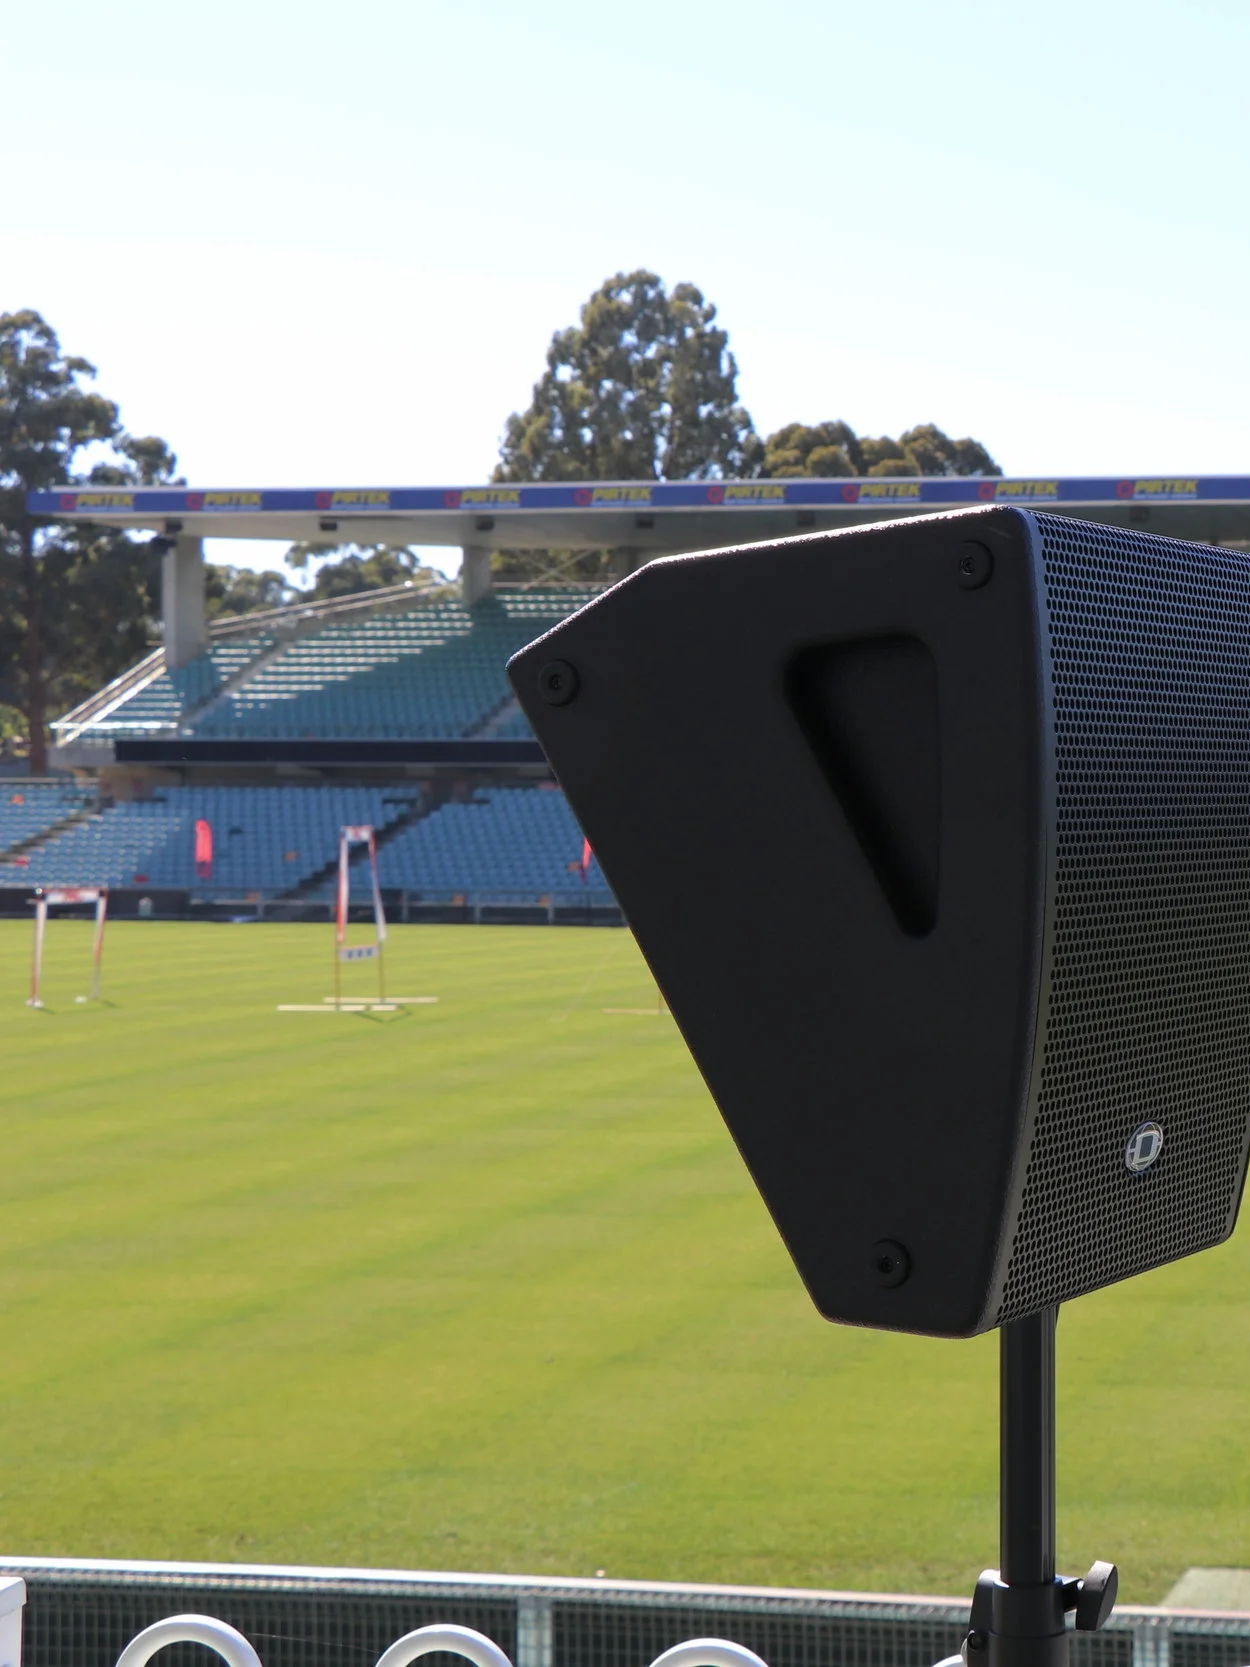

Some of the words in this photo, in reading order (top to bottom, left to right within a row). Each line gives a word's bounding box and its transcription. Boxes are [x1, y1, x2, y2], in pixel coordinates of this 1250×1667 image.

[859, 482, 922, 497] PIRTEK
[995, 481, 1058, 495] PIRTEK
[1134, 479, 1198, 493] PIRTEK
